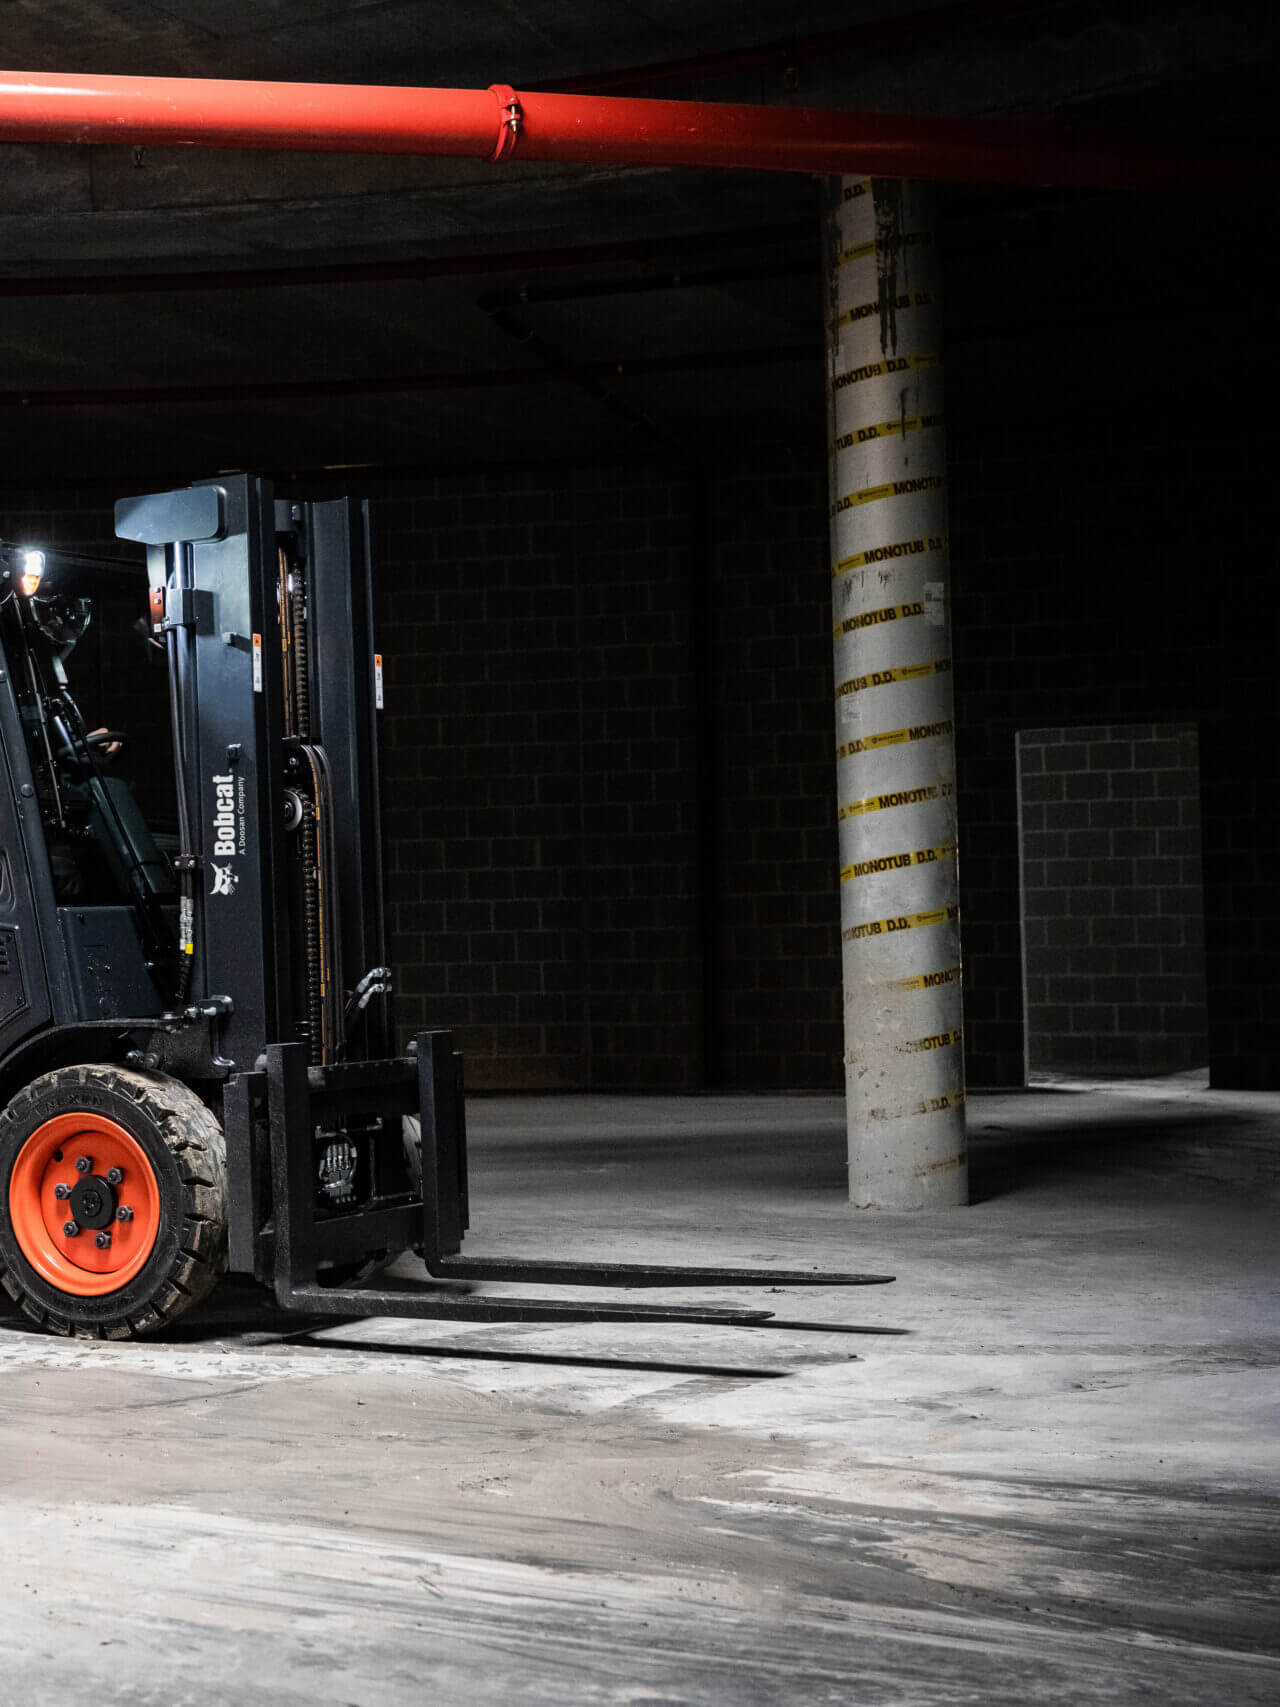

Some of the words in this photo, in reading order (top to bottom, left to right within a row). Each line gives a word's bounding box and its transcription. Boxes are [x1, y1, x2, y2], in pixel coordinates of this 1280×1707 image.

[886, 358, 910, 373] D.D.
[858, 426, 880, 441] D.D.
[863, 539, 925, 564] MONOTUB
[842, 608, 897, 633] MONOTUB
[901, 602, 924, 618] D.D.
[872, 671, 896, 686] D.D.
[237, 776, 246, 815] Company
[212, 774, 236, 856] Bobcat
[238, 816, 246, 847] Doosan
[238, 848, 246, 856] A
[853, 853, 911, 877] MONOTUB
[916, 849, 938, 865] D.D.
[886, 917, 911, 932] D.D.
